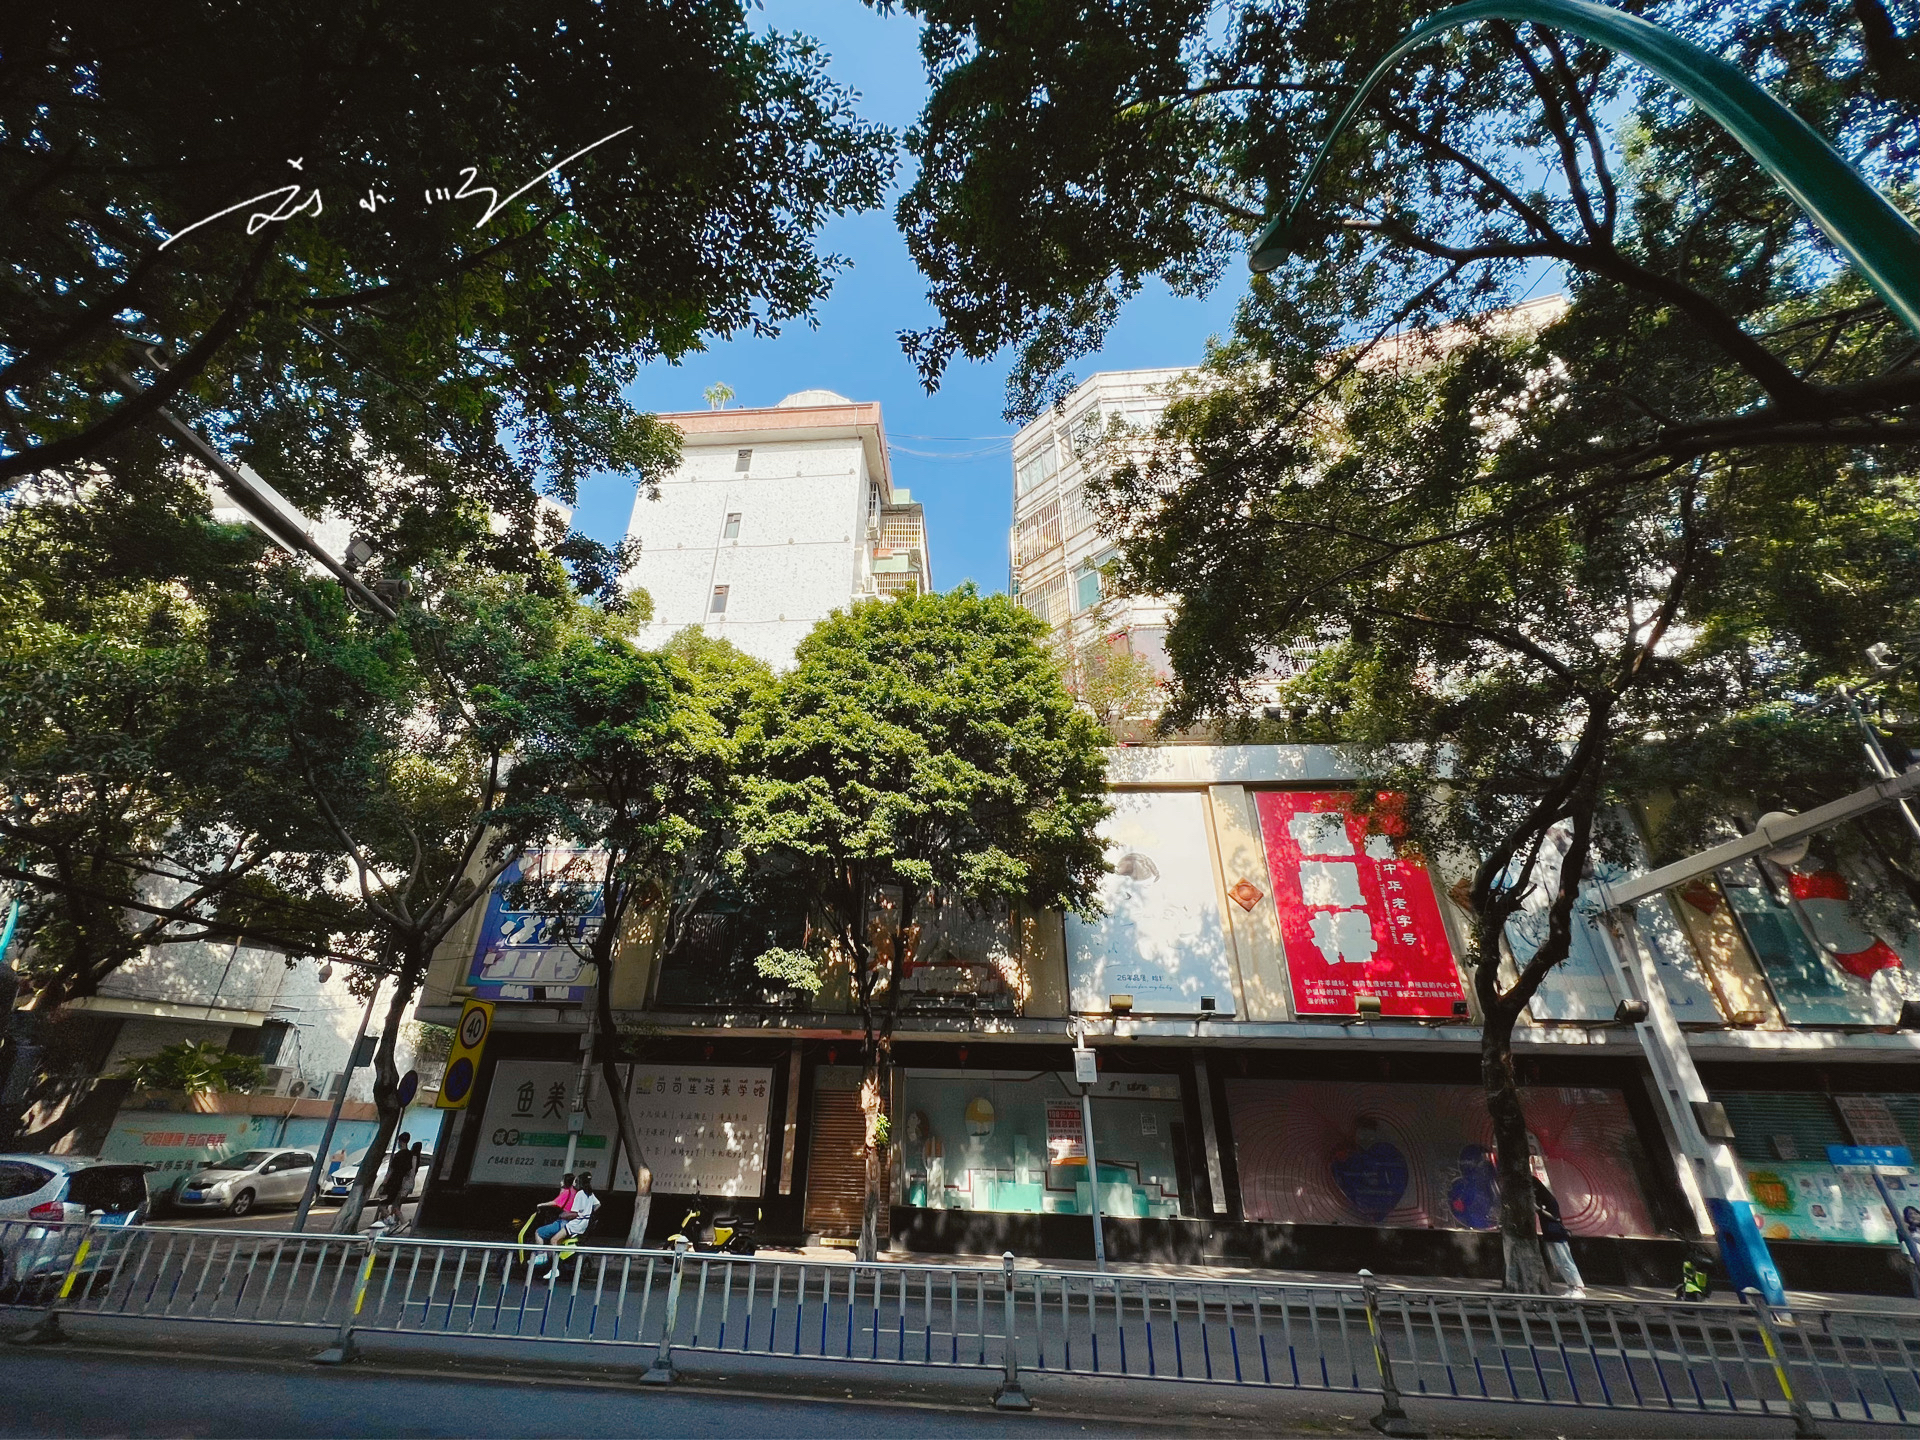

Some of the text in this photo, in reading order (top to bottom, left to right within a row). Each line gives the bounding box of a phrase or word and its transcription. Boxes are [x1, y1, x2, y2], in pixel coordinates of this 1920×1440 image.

[1383, 863, 1417, 946] 中华老字号
[466, 1017, 482, 1039] 40
[657, 1081, 765, 1098] 可可生活美学馆
